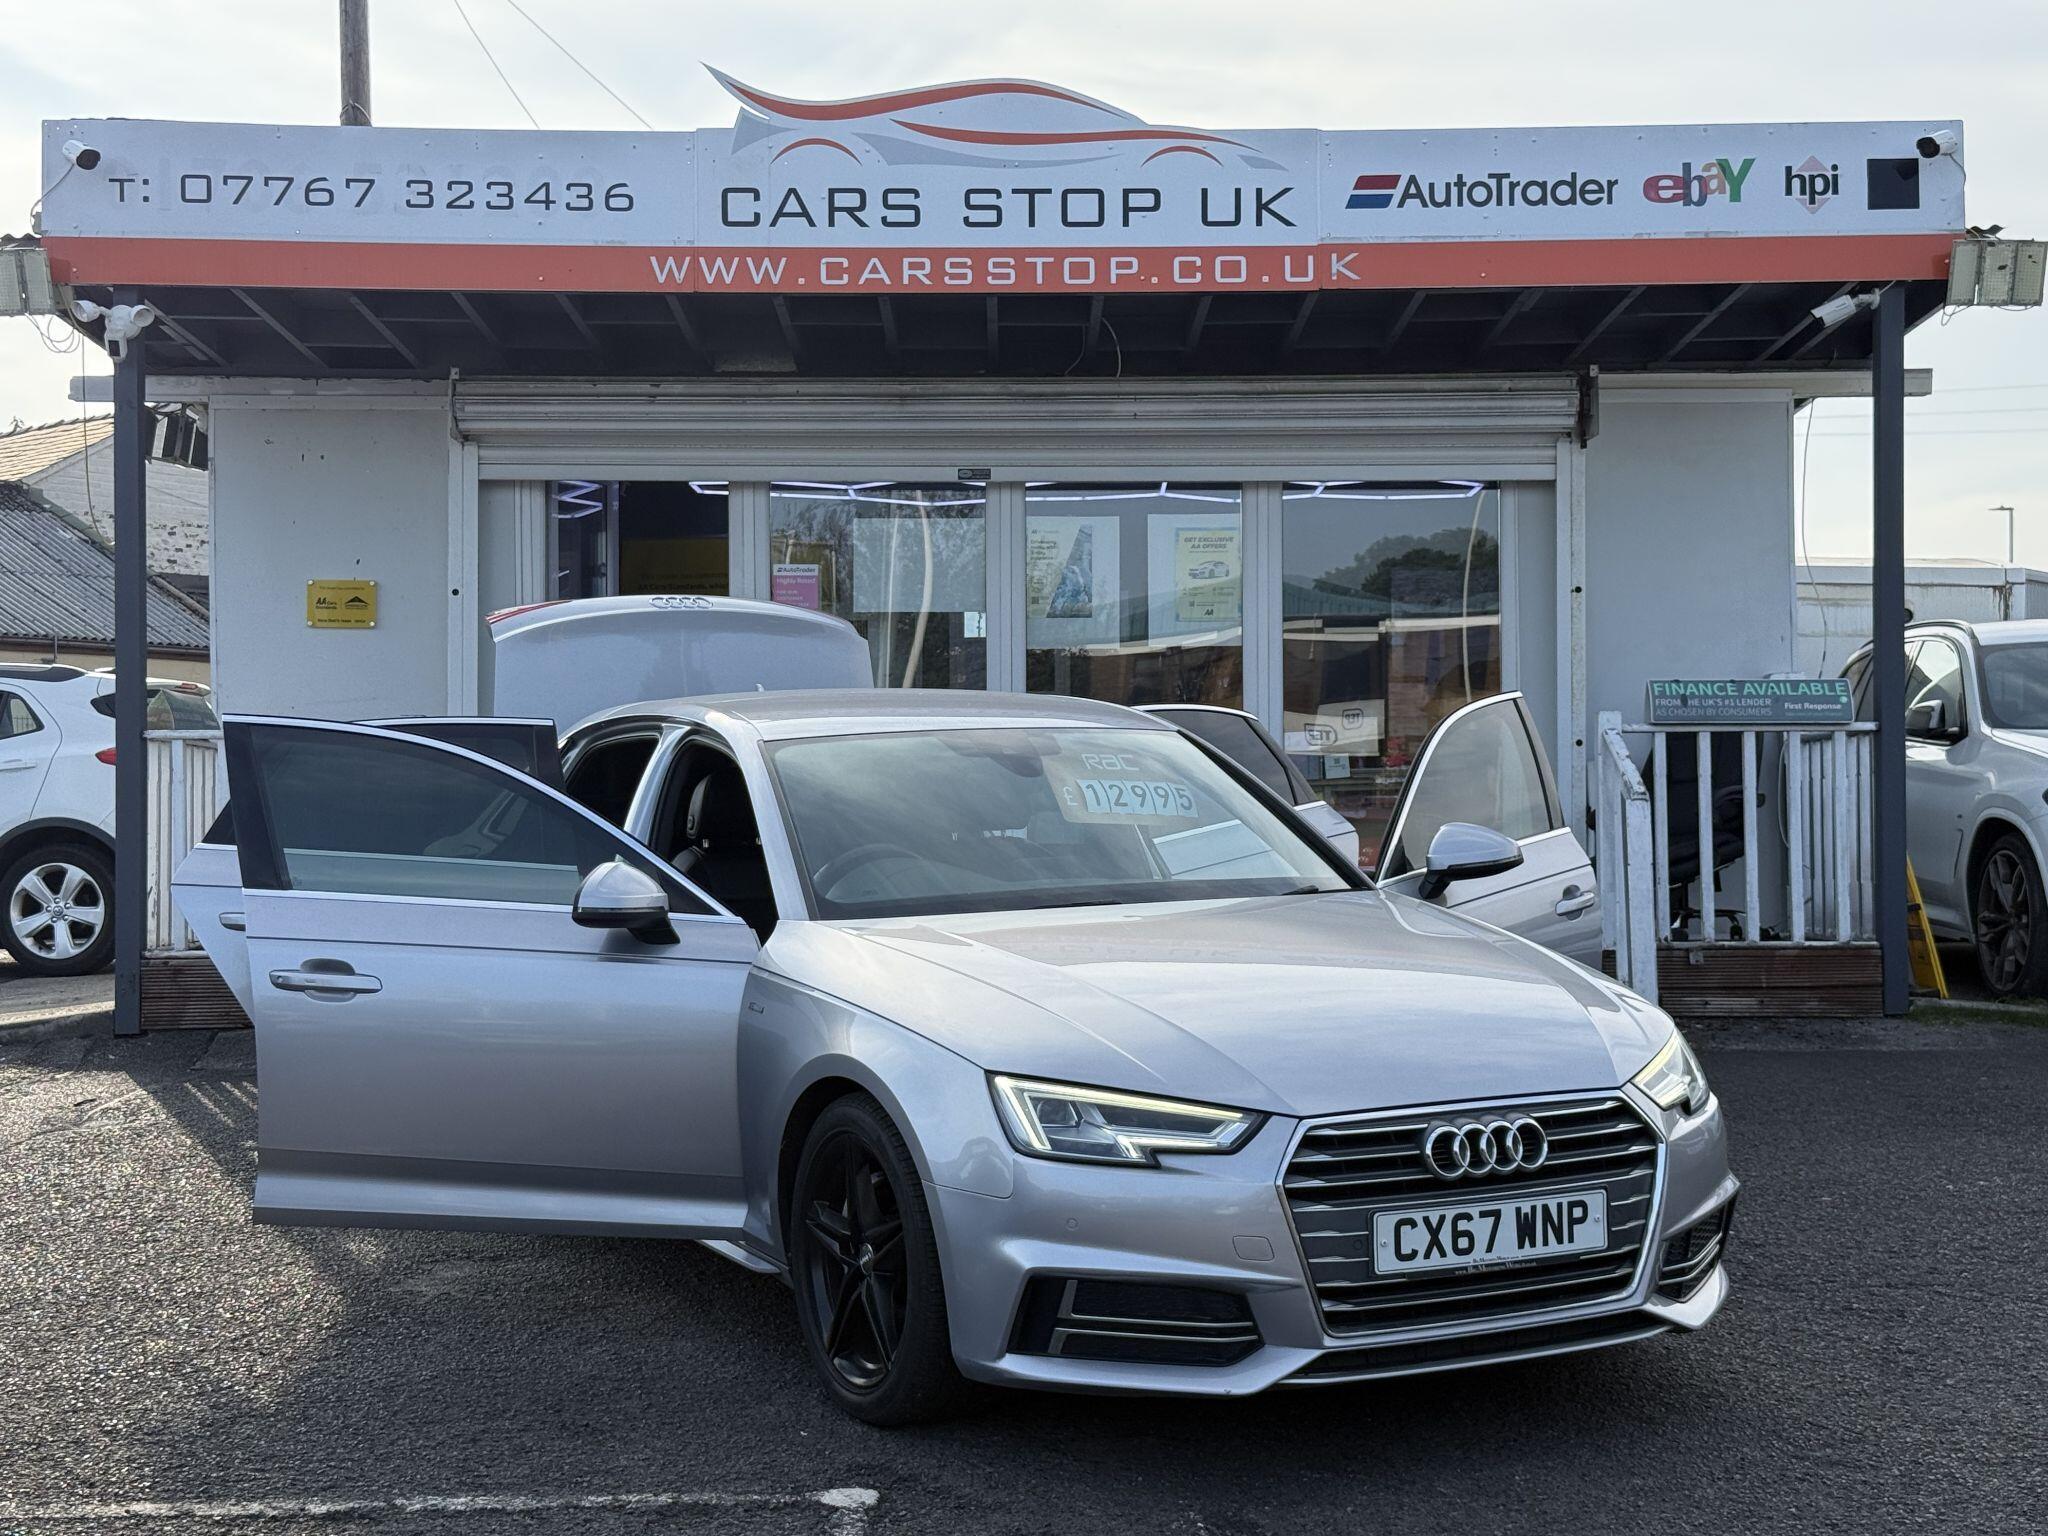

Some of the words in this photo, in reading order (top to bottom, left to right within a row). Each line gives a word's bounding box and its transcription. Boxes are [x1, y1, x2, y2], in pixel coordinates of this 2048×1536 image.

[108, 178, 150, 203] T:
[180, 174, 375, 208] 07767
[405, 179, 635, 212] 323436
[1396, 171, 1619, 209] AutoTrader
[1784, 163, 1840, 206] hpi
[721, 187, 921, 228] CARS
[963, 187, 1162, 228] STOP
[1200, 187, 1297, 228] UK
[650, 252, 1361, 286] WWW.CARSSTOP.CO.UK
[1653, 682, 1739, 696] FINANCE
[1743, 682, 1848, 696] AVAILABLE
[1655, 698, 1681, 707] FROM
[1702, 698, 1723, 707] UK'S
[1736, 698, 1772, 707] LENDER
[1784, 702, 1802, 710] First
[1804, 702, 1842, 711] Response
[1655, 708, 1667, 716] AS
[1668, 708, 1704, 716] CHOSEN
[1706, 708, 1717, 716] BY
[1719, 708, 1772, 716] CONSUMERS
[1393, 1208, 1502, 1262] CX67
[1515, 1199, 1589, 1250] WNP
